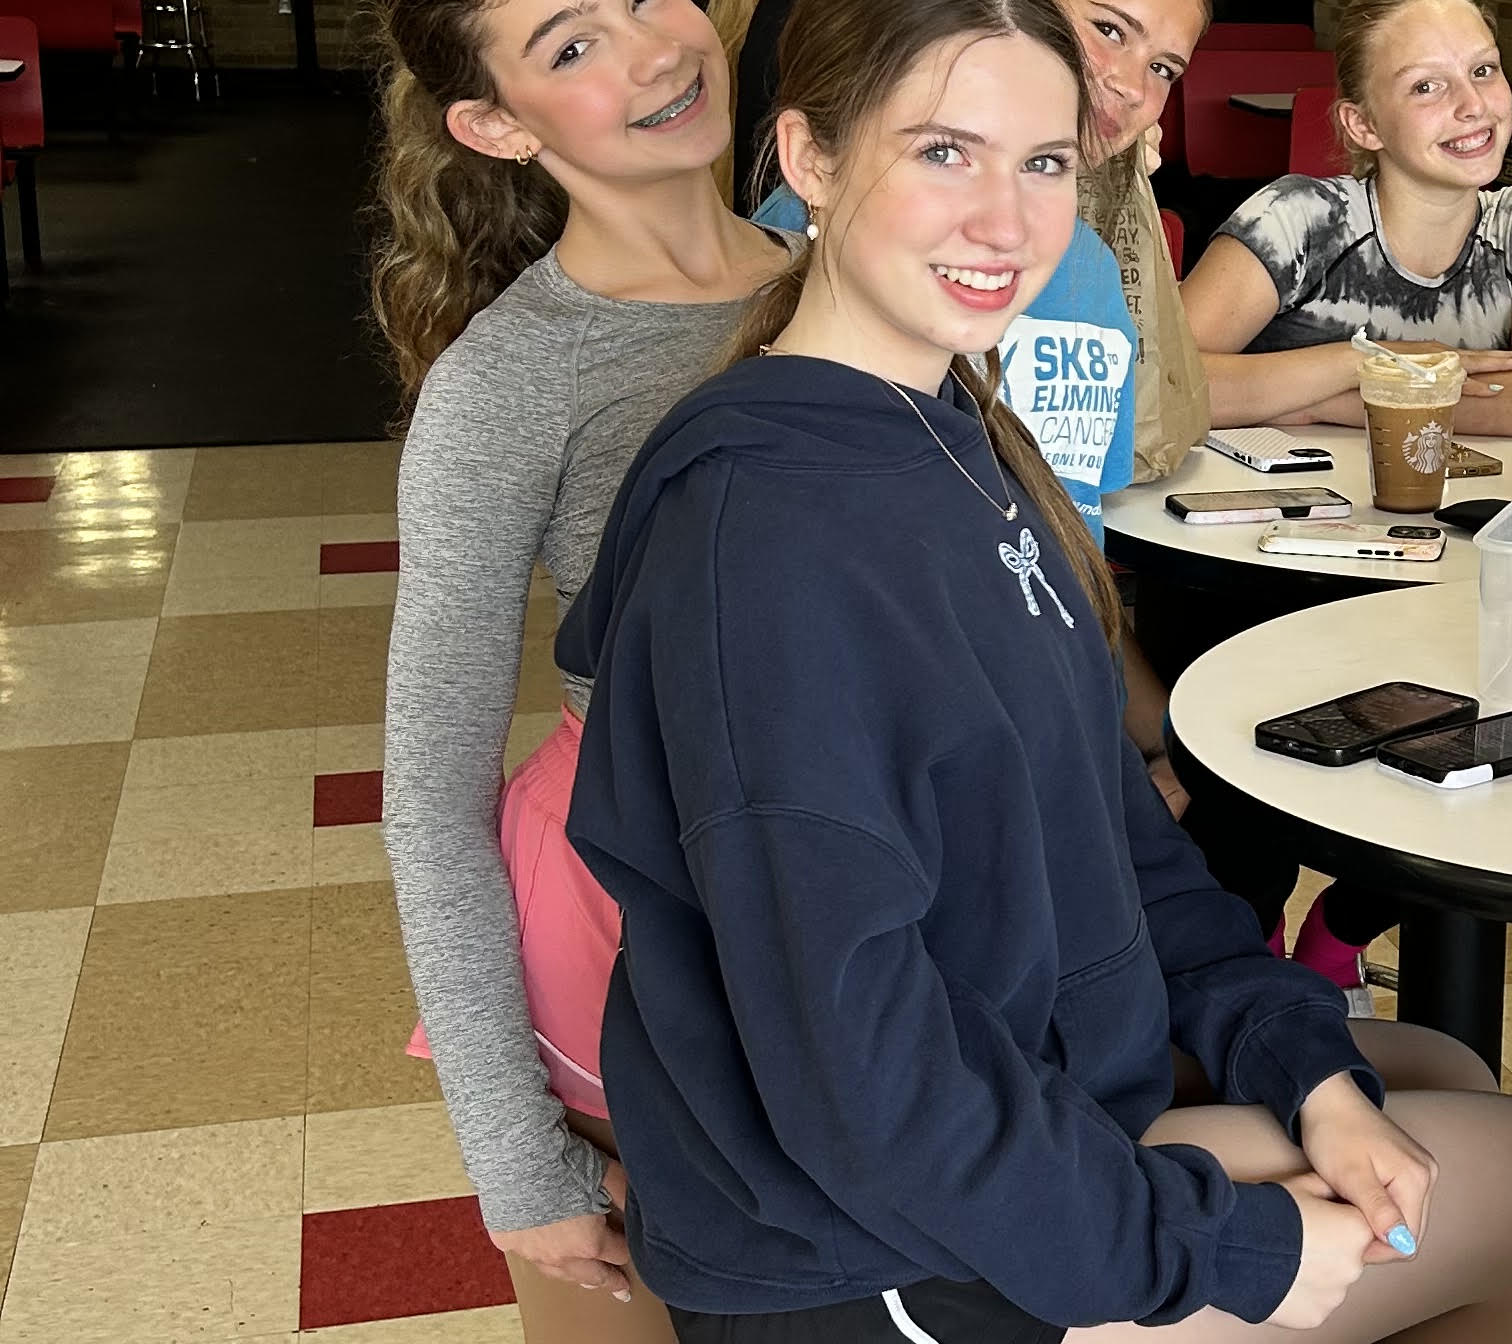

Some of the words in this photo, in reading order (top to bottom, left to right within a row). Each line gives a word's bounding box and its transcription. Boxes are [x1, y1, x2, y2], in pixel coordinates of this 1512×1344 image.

[1034, 336, 1109, 381] SK8
[1107, 353, 1118, 365] TO
[1040, 416, 1114, 446] CANCE
